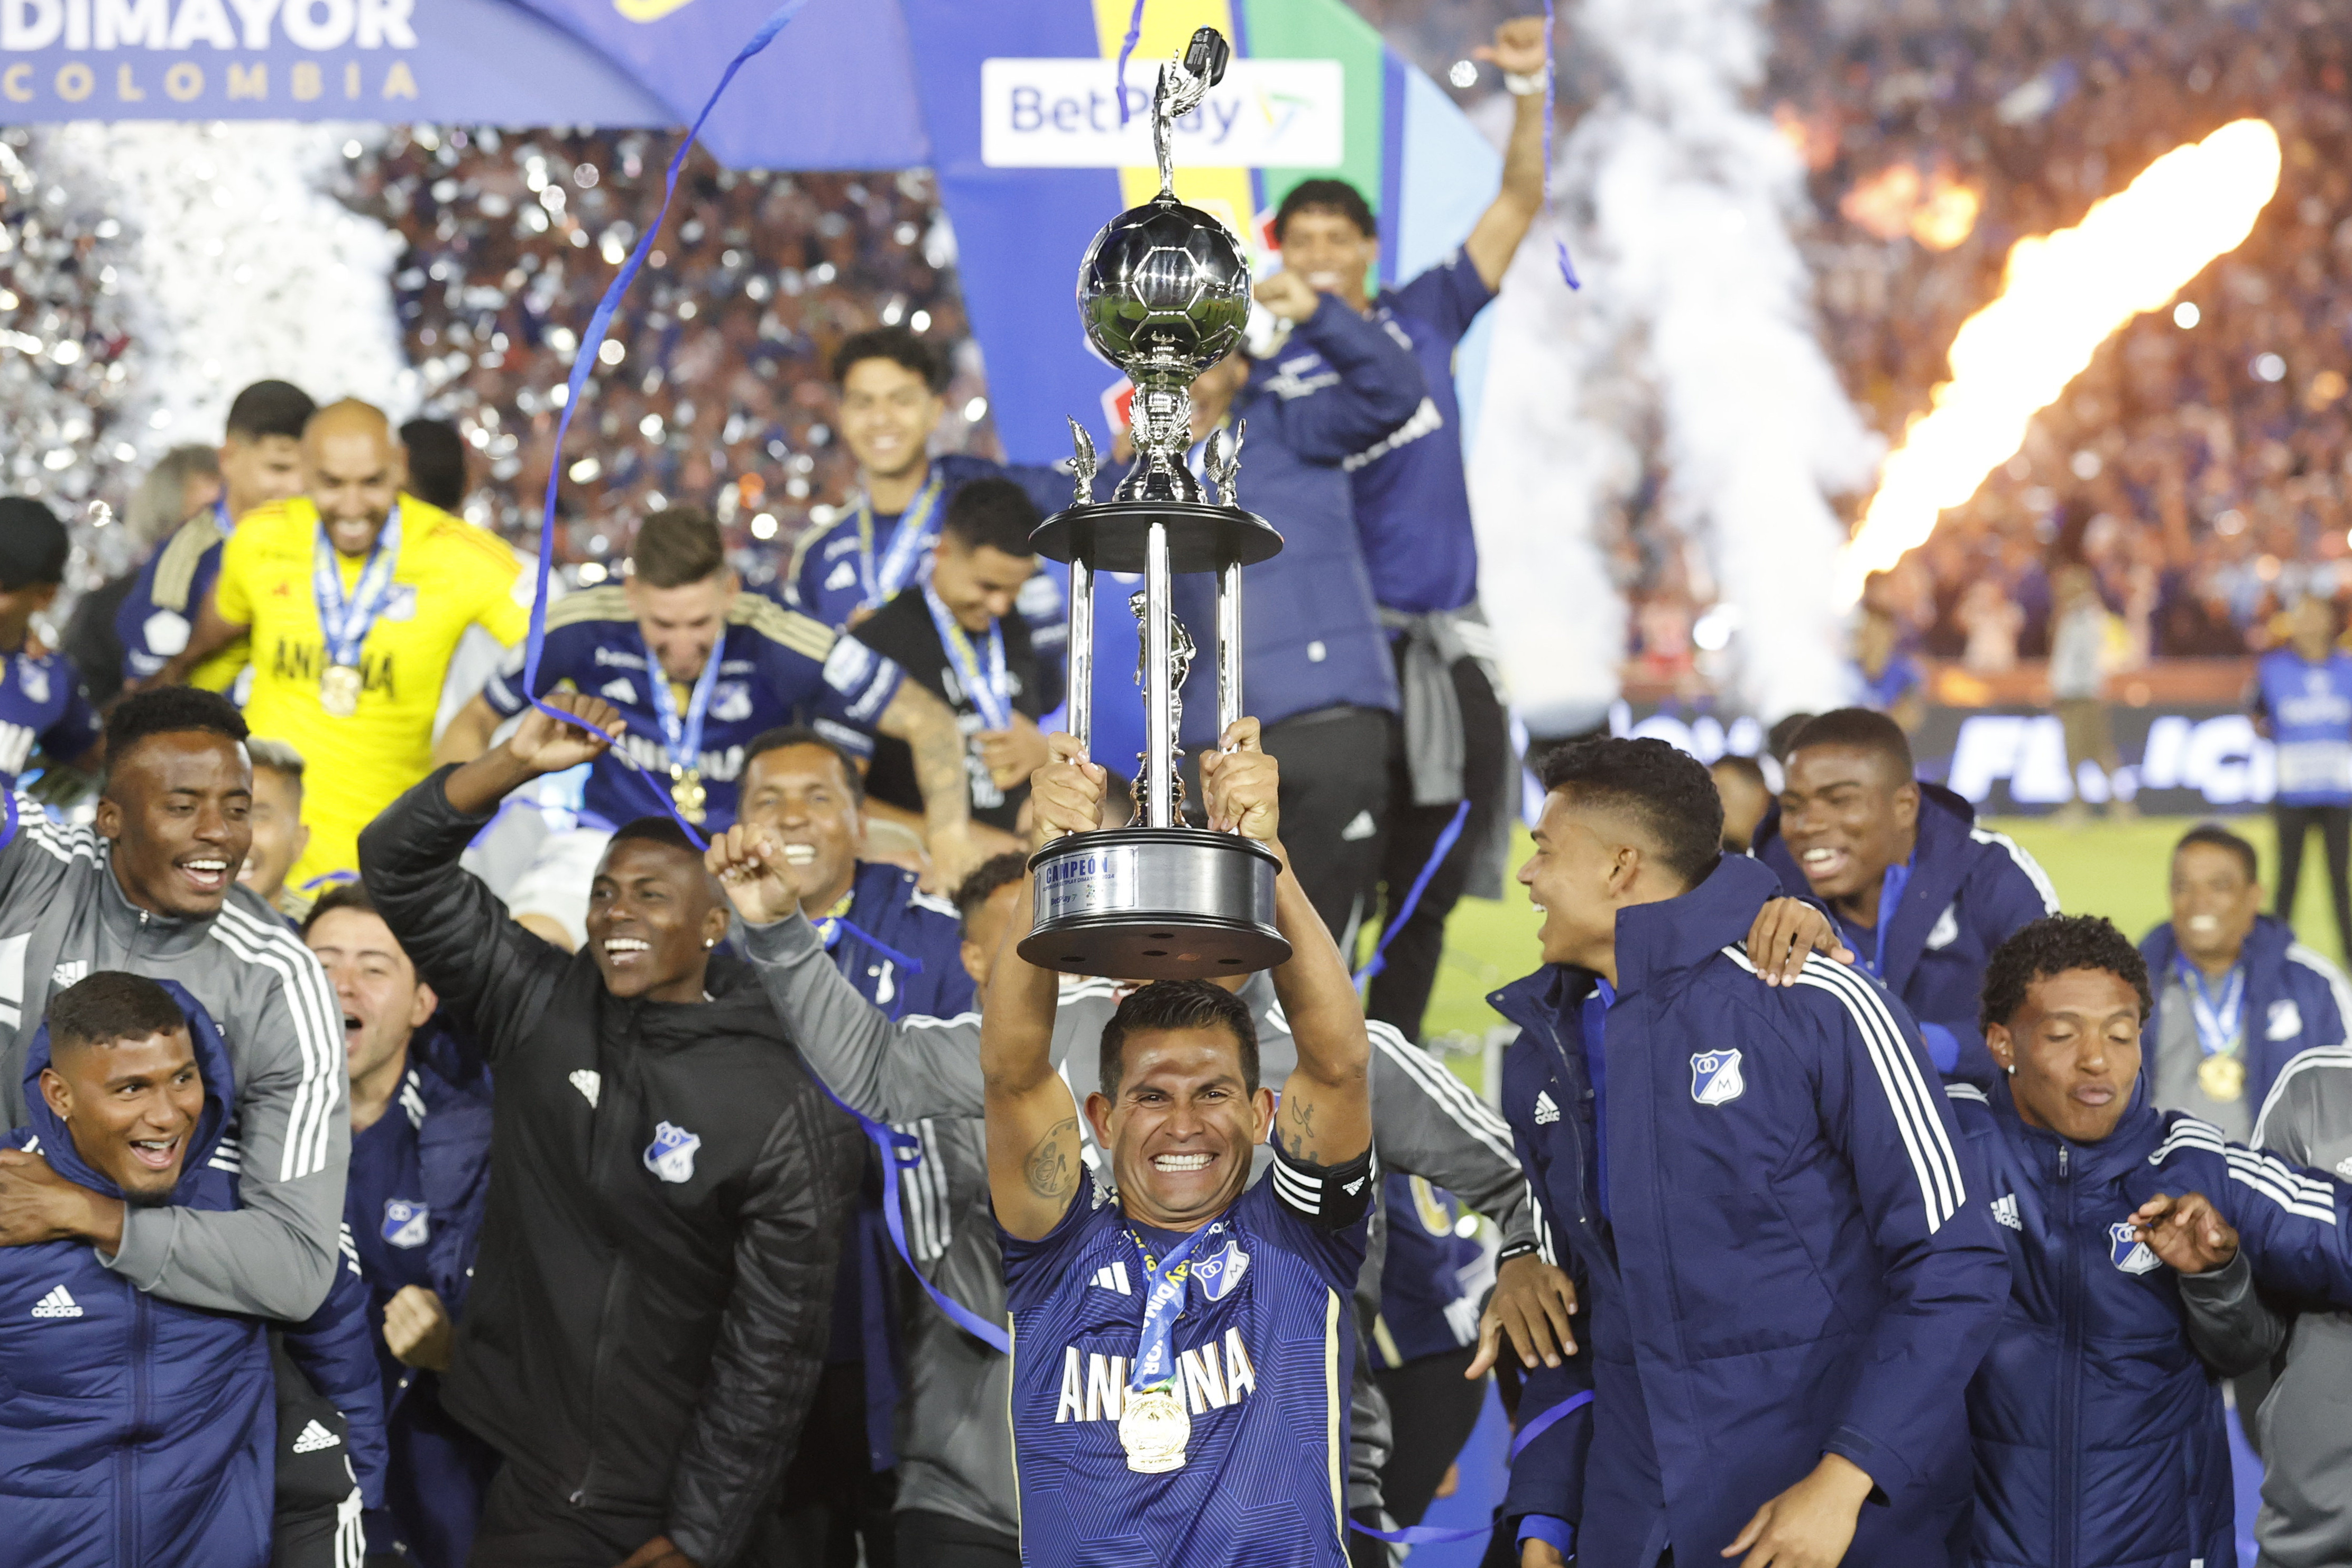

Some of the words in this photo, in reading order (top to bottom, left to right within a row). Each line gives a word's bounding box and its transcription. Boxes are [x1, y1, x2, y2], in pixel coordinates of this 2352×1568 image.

[0, 0, 418, 50] DIMAYOR
[2, 60, 419, 102] COLOMBIA
[1011, 85, 1241, 147] BetPay
[31, 1303, 84, 1318] adidas
[1054, 1325, 1257, 1423] ANNA
[292, 1433, 341, 1454] adidas
